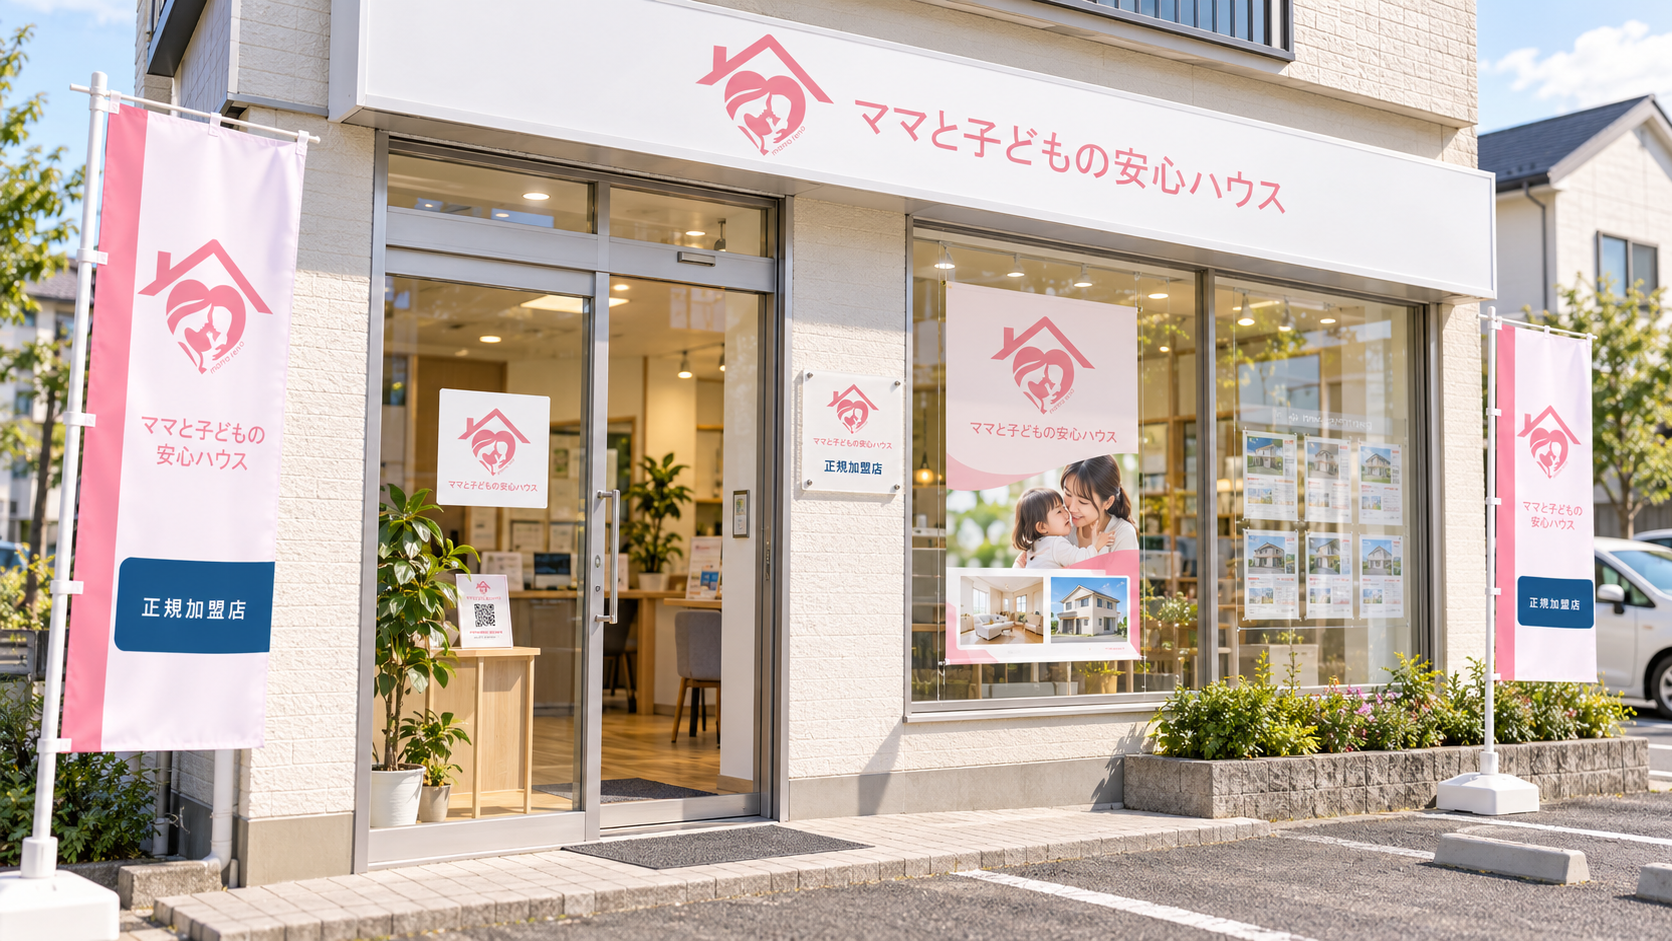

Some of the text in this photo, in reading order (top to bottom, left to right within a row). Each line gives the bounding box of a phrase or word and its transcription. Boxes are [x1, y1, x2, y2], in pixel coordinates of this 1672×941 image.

[854, 99, 1286, 215] ママと子どもの安心ハウス
[141, 415, 265, 444] ママと子どもの
[970, 422, 1117, 443] ママと子どもの安心ハウス
[813, 437, 893, 450] ママと子どもの安心ハウス
[156, 444, 249, 470] 安心ハウス
[824, 459, 883, 475] 正規加盟店
[448, 480, 538, 492] ママと子どもの安心ハウス
[1522, 501, 1583, 516] ママと子どもの
[1531, 514, 1576, 530] 安心ハウス
[141, 597, 246, 620] 正規加盟店
[1529, 597, 1580, 611] 正規加盟店
